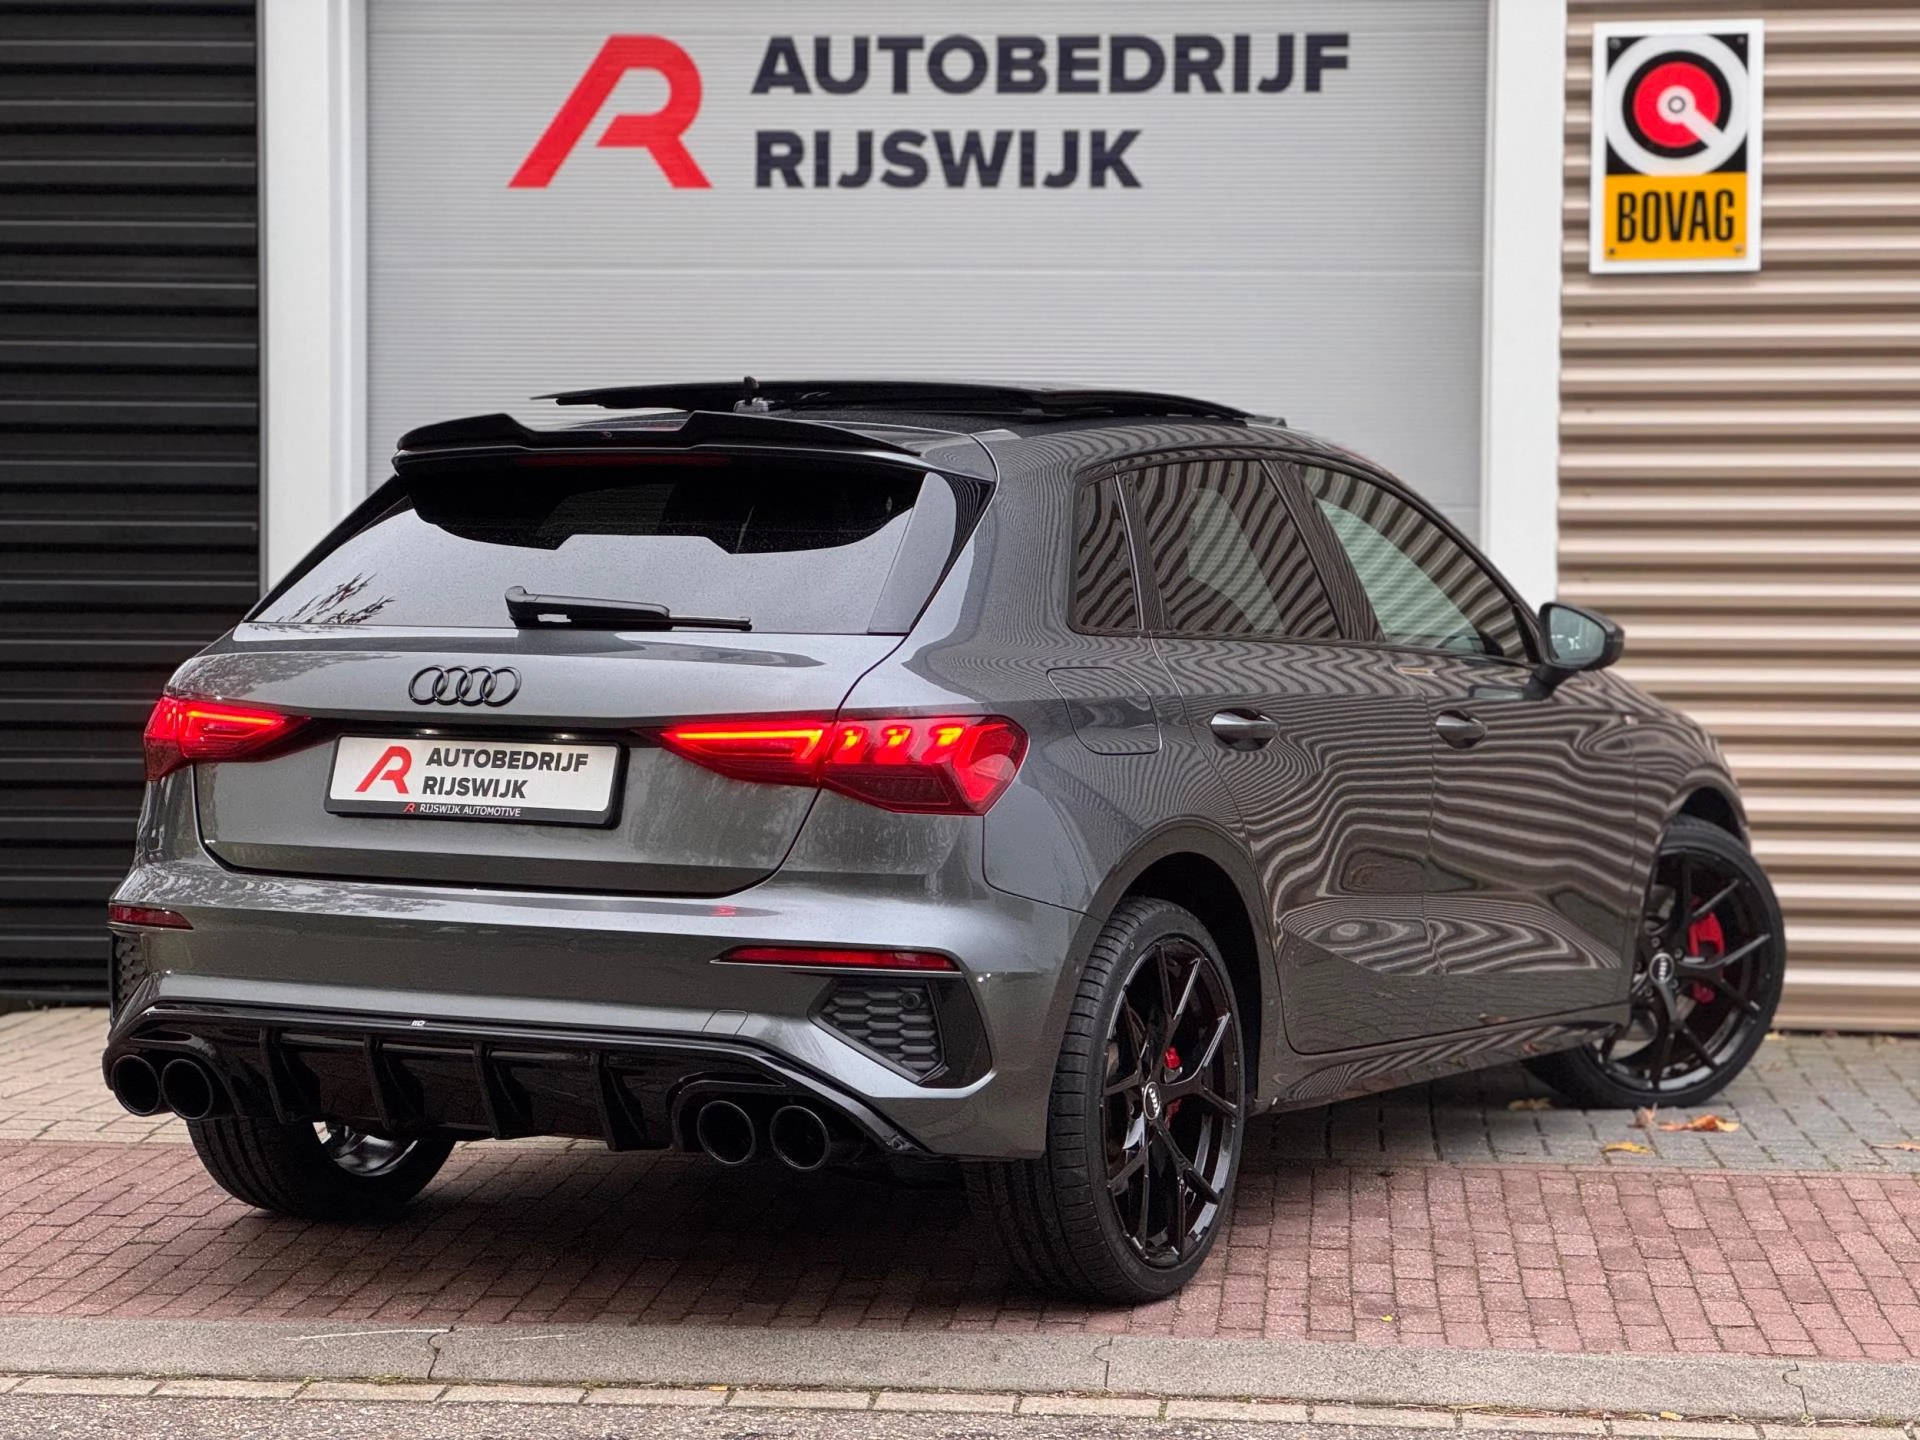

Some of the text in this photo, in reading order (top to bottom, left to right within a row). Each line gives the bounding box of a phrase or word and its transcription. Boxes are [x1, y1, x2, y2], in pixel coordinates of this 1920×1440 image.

[752, 33, 1349, 94] AUTOBEDRIJF
[756, 130, 1141, 188] RIJSWIJK
[1616, 189, 1735, 243] BOVAG
[426, 748, 589, 772] AUTOBEDRIJF
[422, 776, 528, 799] RIJSWIJK
[420, 803, 521, 817] RIJSWIJK AUTOMOTIVE
